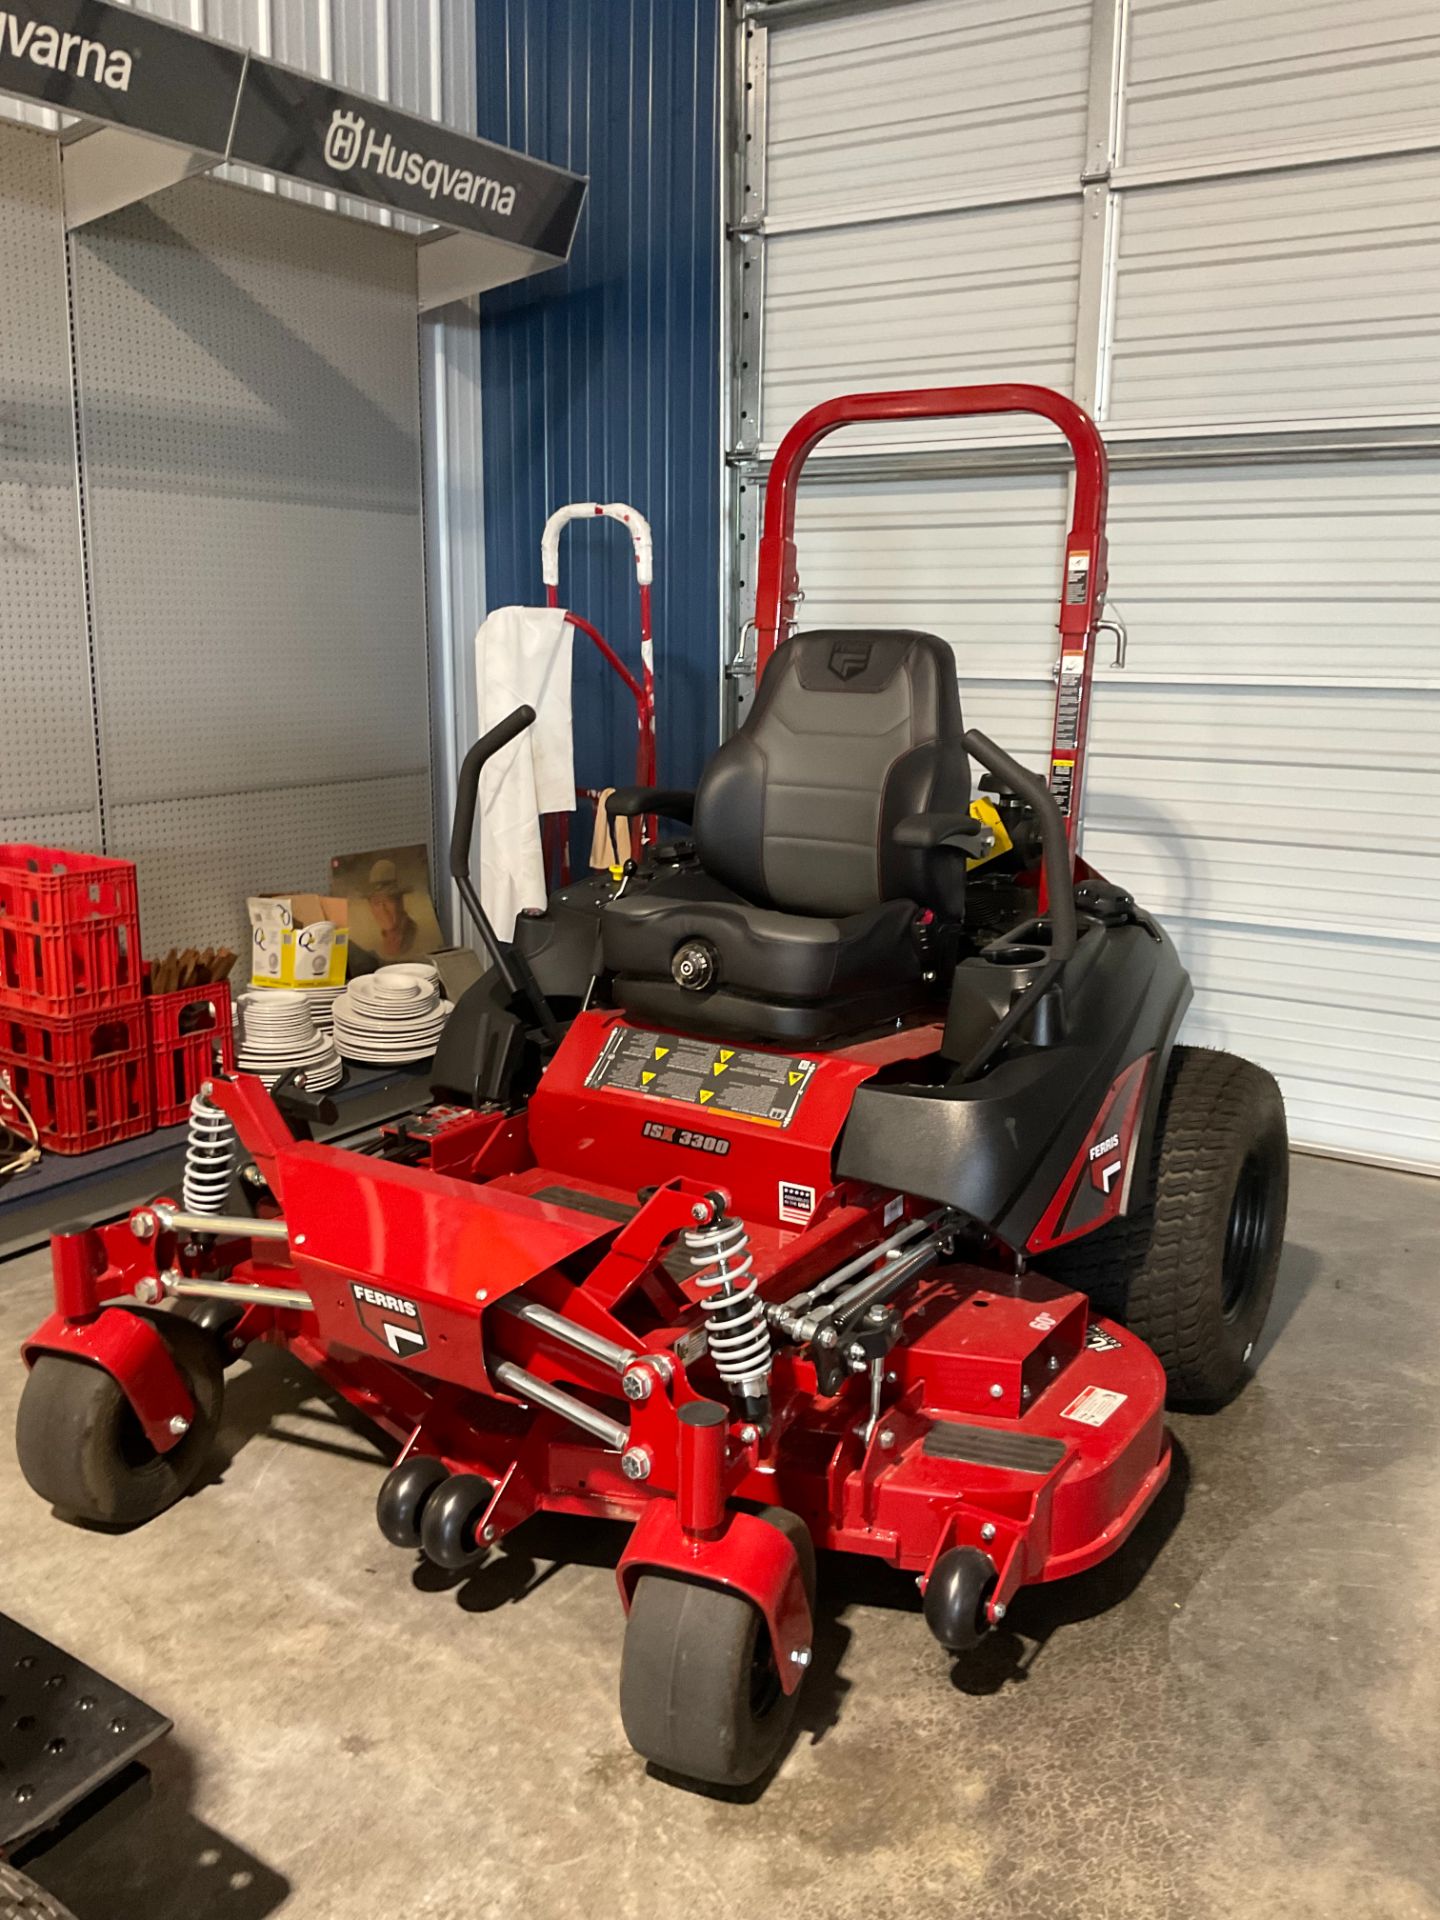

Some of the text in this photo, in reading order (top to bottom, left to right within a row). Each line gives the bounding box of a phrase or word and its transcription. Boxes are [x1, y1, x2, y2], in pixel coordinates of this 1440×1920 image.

[0, 12, 132, 91] varna
[362, 128, 516, 215] Husqvarna
[643, 1122, 729, 1154] ISX 3300
[1090, 1134, 1119, 1160] FERRIS
[353, 1285, 417, 1317] FERRIS
